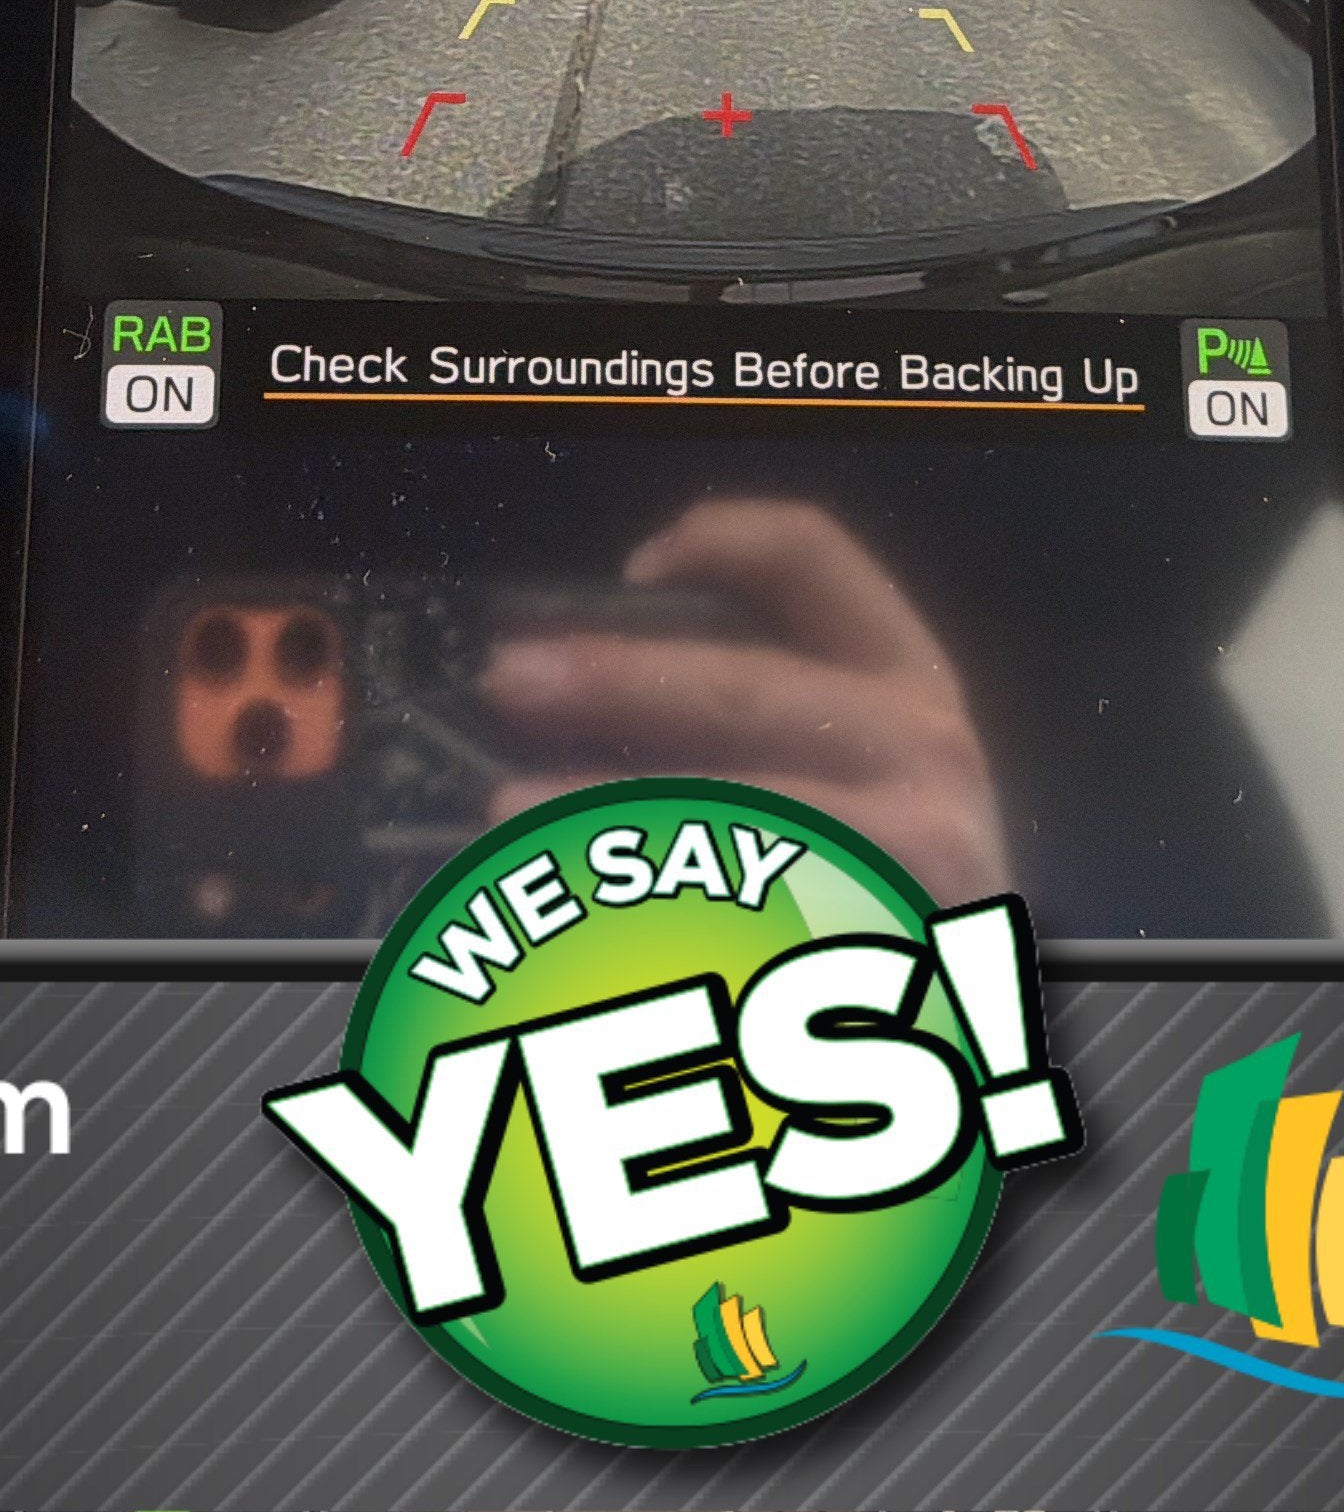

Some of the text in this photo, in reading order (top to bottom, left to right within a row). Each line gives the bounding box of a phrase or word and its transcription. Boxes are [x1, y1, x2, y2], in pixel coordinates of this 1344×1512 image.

[113, 315, 212, 353] RAB
[270, 344, 1138, 402] Check Surroundings Before Backing Up
[126, 374, 193, 413] ON
[1206, 390, 1270, 426] ON
